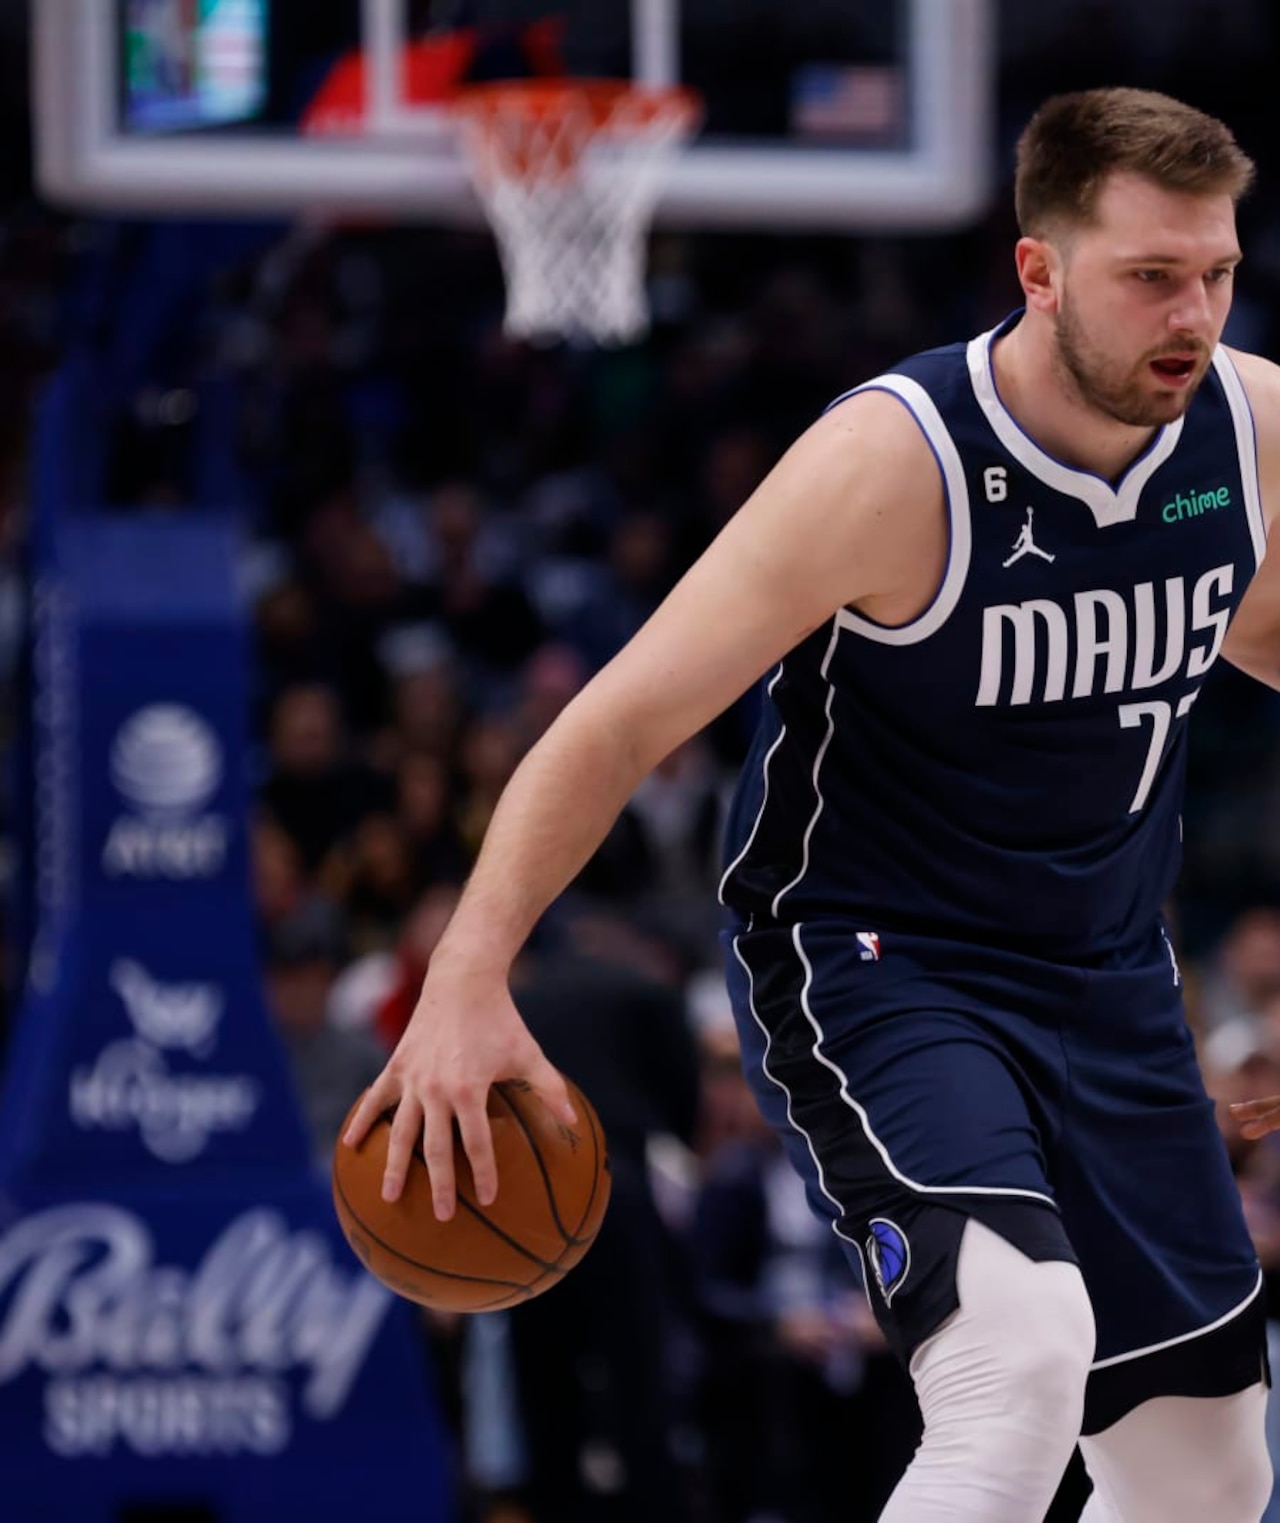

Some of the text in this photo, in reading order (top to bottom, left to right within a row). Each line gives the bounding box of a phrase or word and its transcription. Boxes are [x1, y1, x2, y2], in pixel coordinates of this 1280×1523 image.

[983, 466, 1008, 503] 6
[1162, 485, 1231, 524] chime
[975, 562, 1235, 707] MAVS
[1118, 685, 1200, 815] 7
[0, 1203, 392, 1420] Bally
[43, 1373, 291, 1457] SPORTS
